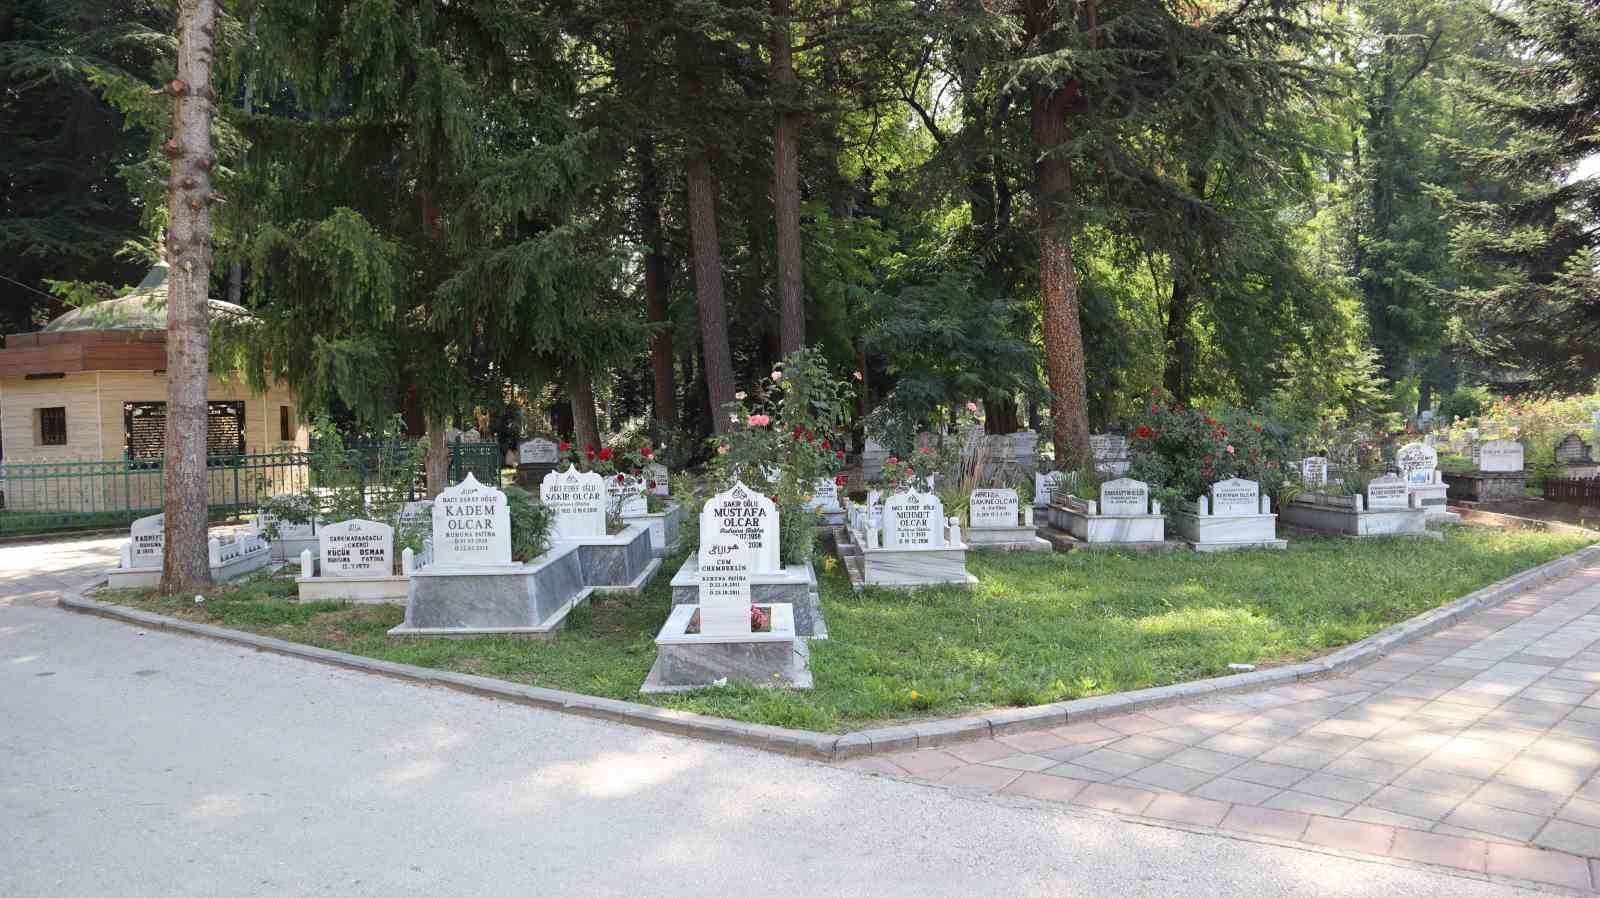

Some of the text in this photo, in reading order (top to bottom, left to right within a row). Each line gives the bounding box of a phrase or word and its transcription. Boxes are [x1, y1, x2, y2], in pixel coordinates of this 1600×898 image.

[572, 492, 600, 501] OLCAR
[446, 505, 495, 517] KADEM
[714, 507, 767, 517] MUSTAFA
[896, 511, 929, 519] MEHMET
[448, 519, 494, 530] OLCAR
[723, 517, 760, 527] OLCAR
[900, 519, 928, 527] OLCAR
[359, 548, 385, 556] OSMAN
